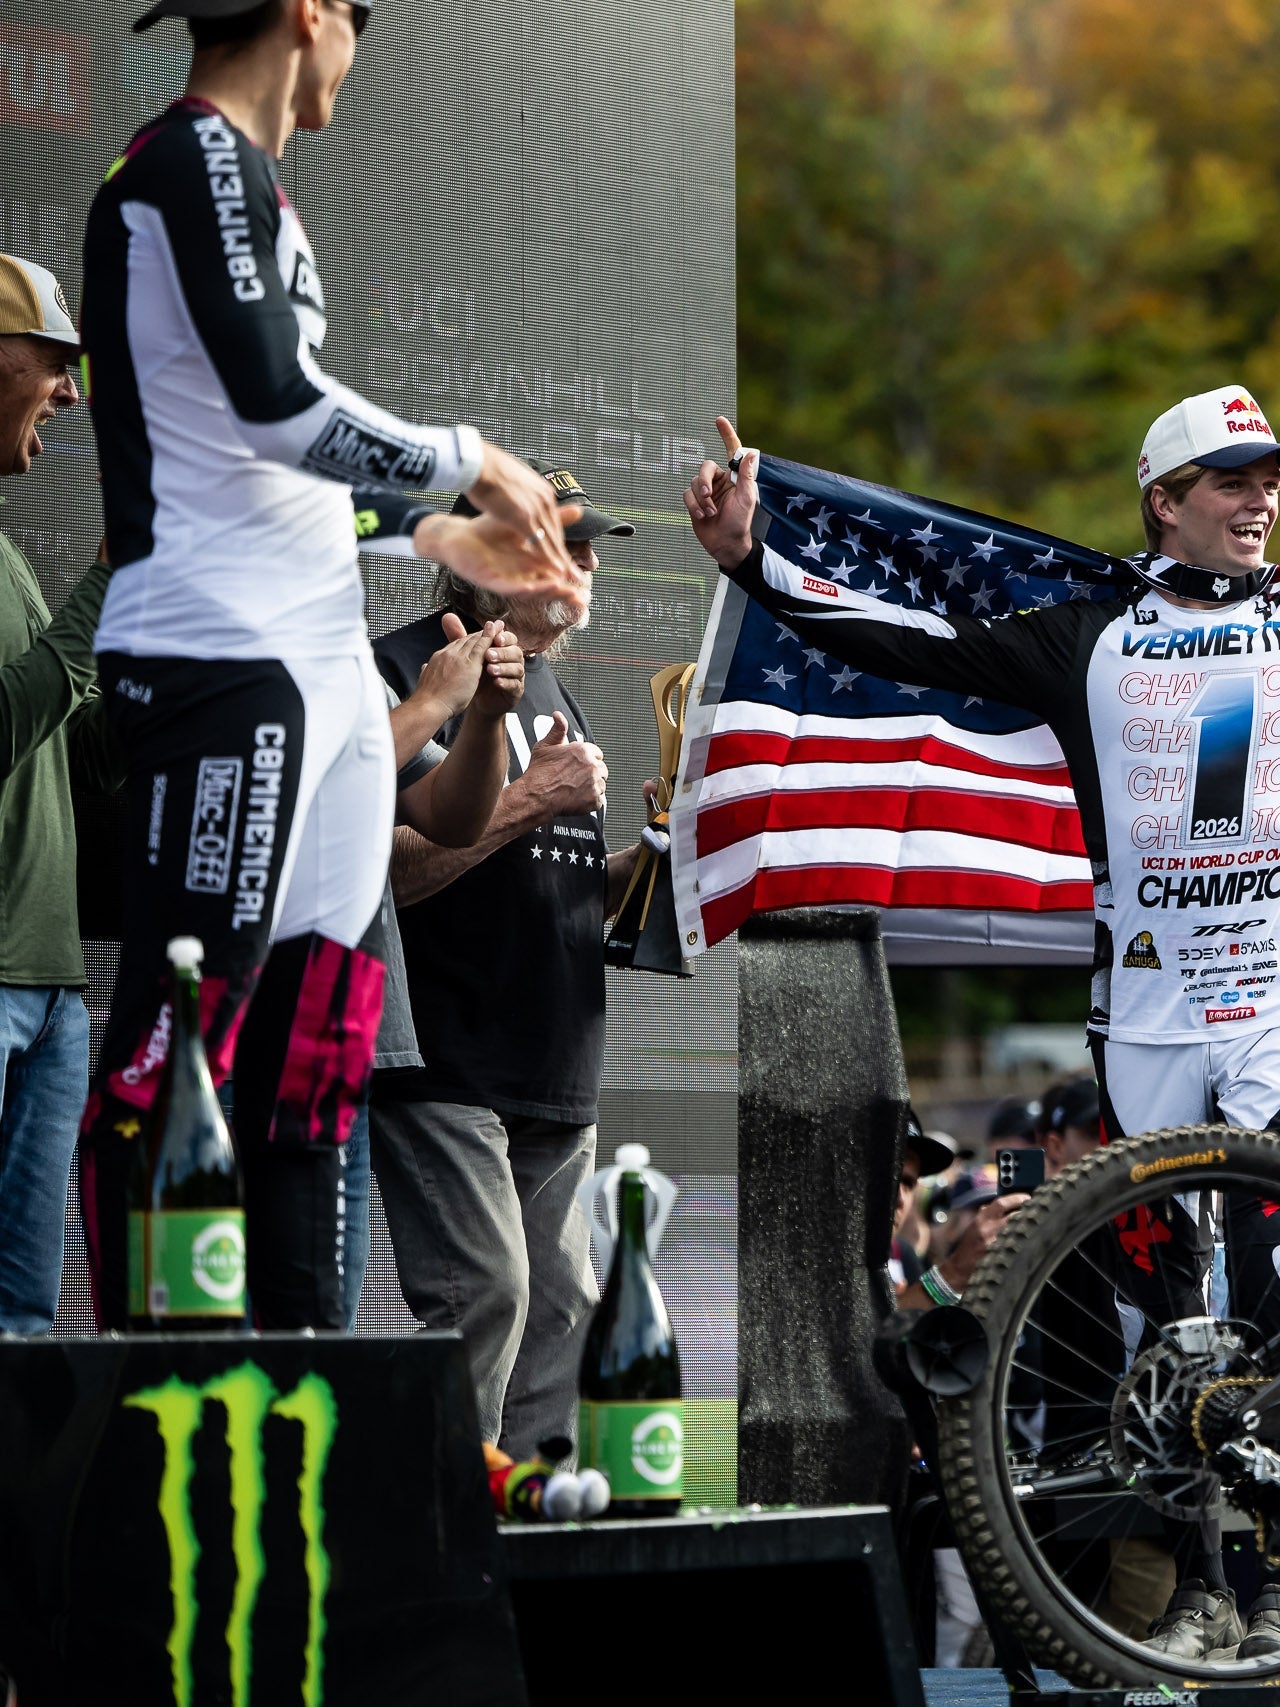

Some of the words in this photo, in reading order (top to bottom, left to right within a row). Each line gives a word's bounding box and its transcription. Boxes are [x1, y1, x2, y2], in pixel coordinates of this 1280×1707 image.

[388, 278, 476, 341] UCI
[367, 346, 666, 423] DOWNHILL
[1226, 418, 1254, 433] Red
[594, 426, 706, 474] CUP
[1178, 669, 1262, 848] 1
[192, 764, 236, 889] Muc-Off
[553, 825, 570, 837] ANNA
[570, 827, 597, 841] NEWKIRK
[1193, 817, 1239, 838] 2026
[1141, 857, 1164, 870] UCI
[1167, 857, 1186, 871] DH
[1190, 853, 1235, 870] WORLD
[1237, 850, 1265, 866] CUP
[1191, 919, 1267, 937] TRP
[1178, 945, 1226, 960] 5DEV
[1181, 968, 1196, 979] FOX
[1200, 965, 1241, 977] Continental
[1208, 1008, 1252, 1021] LOCTITE
[1130, 1149, 1214, 1183] Continental
